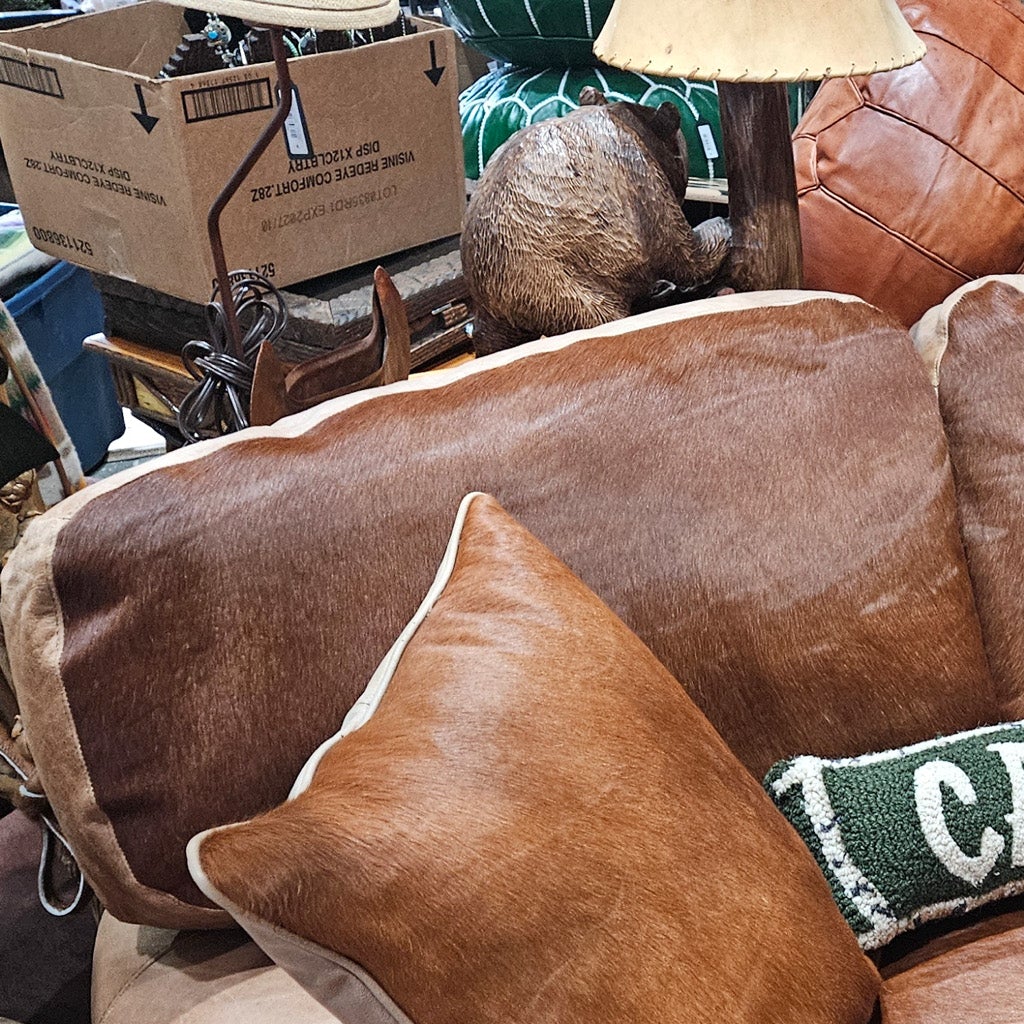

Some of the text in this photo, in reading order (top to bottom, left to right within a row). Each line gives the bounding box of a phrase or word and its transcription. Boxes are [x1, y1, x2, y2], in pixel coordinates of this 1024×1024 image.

[50, 151, 132, 182] DISP X12CLBTRY
[288, 140, 380, 174] DISP X12CLBTRY
[93, 176, 132, 197] REDEYE
[250, 151, 416, 203] VISINE REDEYE COMFORT.28Z
[133, 187, 167, 206] VISINE
[32, 226, 94, 256] 521136800
